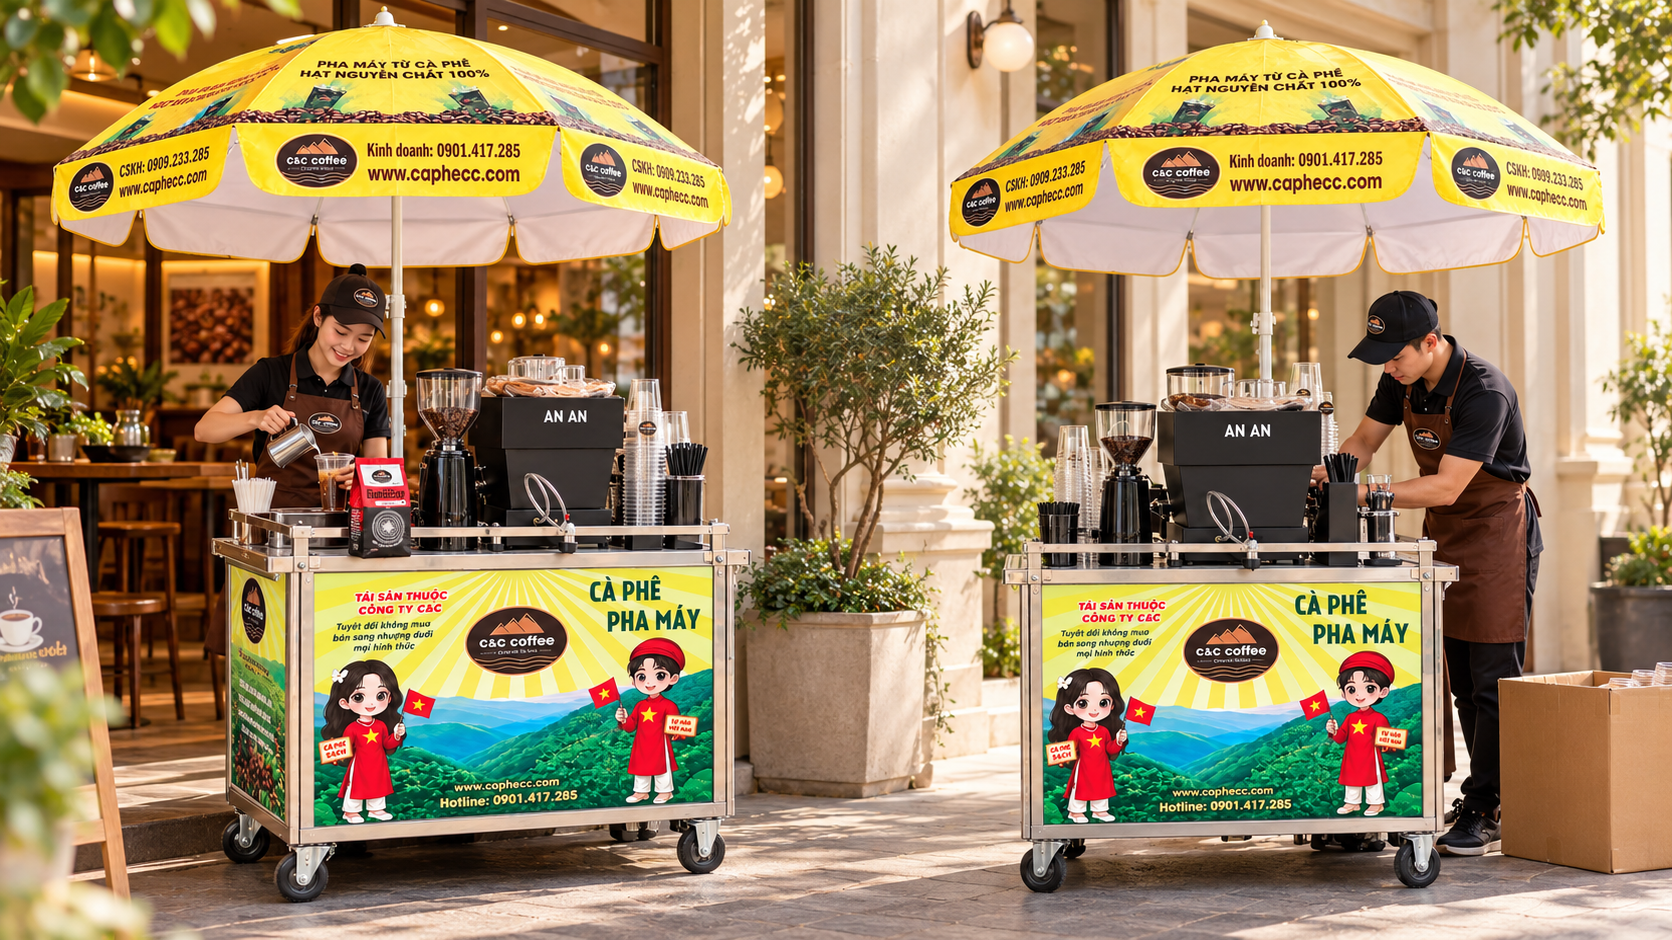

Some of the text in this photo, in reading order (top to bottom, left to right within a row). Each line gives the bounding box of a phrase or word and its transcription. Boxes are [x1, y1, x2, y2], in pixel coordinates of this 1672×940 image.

[317, 60, 349, 69] PHA
[415, 59, 438, 69] CÀ
[299, 70, 332, 80] HẠT
[449, 69, 490, 79] 100%
[1188, 75, 1220, 83] PHA
[1224, 73, 1259, 82] MÁY
[1286, 69, 1309, 80] CÀ
[1170, 85, 1202, 95] HẠT
[1320, 78, 1362, 89] 100%
[367, 142, 521, 158] Kinh doanh: 0901.417.285
[119, 146, 210, 178] CSKH: 0909.233.285
[311, 155, 347, 166] coffee
[1229, 150, 1383, 168] Kinh doanh: 0901.417.285
[368, 164, 521, 185] www.caphecc.com
[632, 158, 655, 177] CSKH:
[1175, 166, 1211, 178] coffee
[1506, 161, 1531, 179] CSKH:
[119, 169, 207, 198] www.caphecc.com
[1005, 177, 1028, 193] CSKH:
[1229, 173, 1383, 195] www.caphecc.com
[543, 409, 587, 423] AN AN
[1224, 423, 1271, 437] AN AN
[589, 574, 661, 603] CÀ PHÊ
[398, 604, 413, 614] TY
[1294, 589, 1367, 615] CÀ PHÊ
[607, 604, 701, 632] PHA MÁY
[1119, 613, 1134, 622] TY
[1137, 613, 1161, 622] C&C
[1313, 618, 1409, 645] PHA MÁY
[510, 635, 555, 648] coffee
[1224, 644, 1267, 656] coffee
[439, 790, 578, 808] Hotline: 0901.417.285
[1159, 798, 1292, 813] Hotline: 0901.417.285
